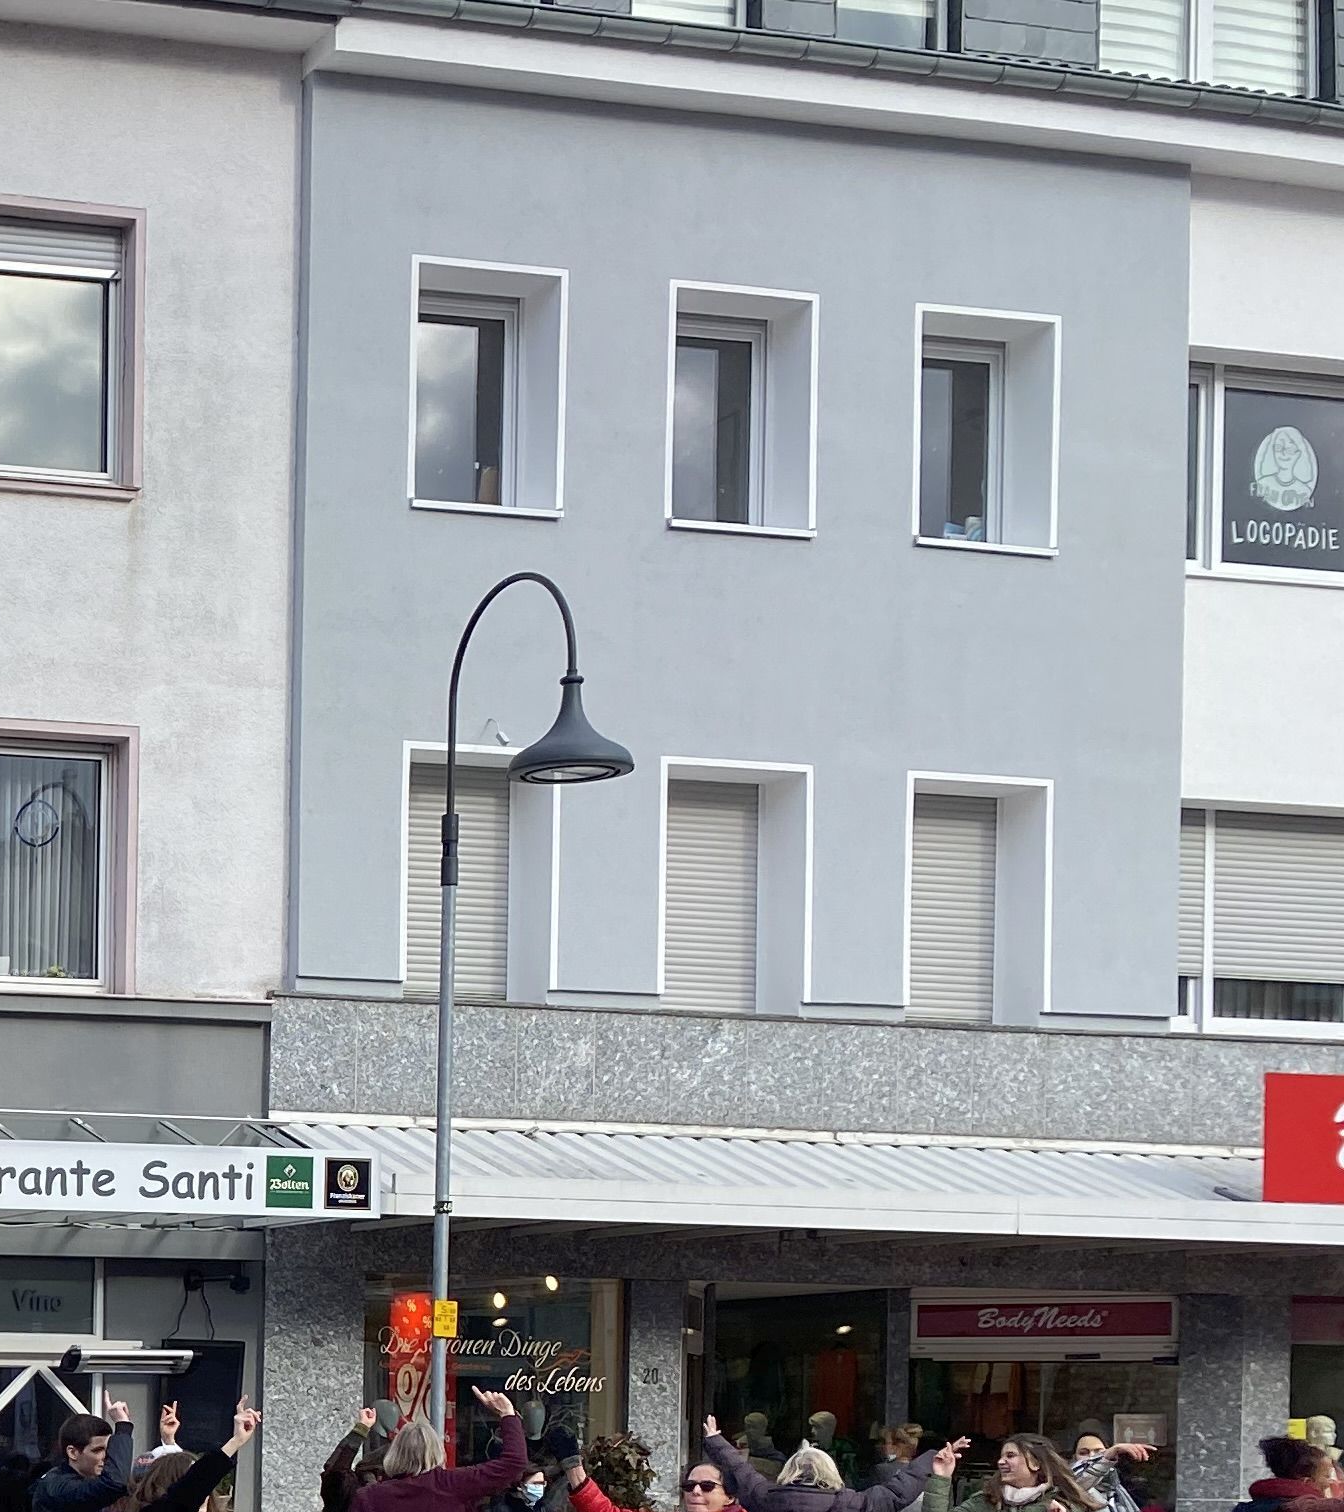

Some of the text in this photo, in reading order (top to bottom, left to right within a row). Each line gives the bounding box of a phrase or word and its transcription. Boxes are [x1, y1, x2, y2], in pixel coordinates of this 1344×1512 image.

[138, 1160, 255, 1201] Santi
[499, 1329, 563, 1367] Dinge
[504, 1366, 607, 1395] des Lebens
[643, 1368, 659, 1385] 20
